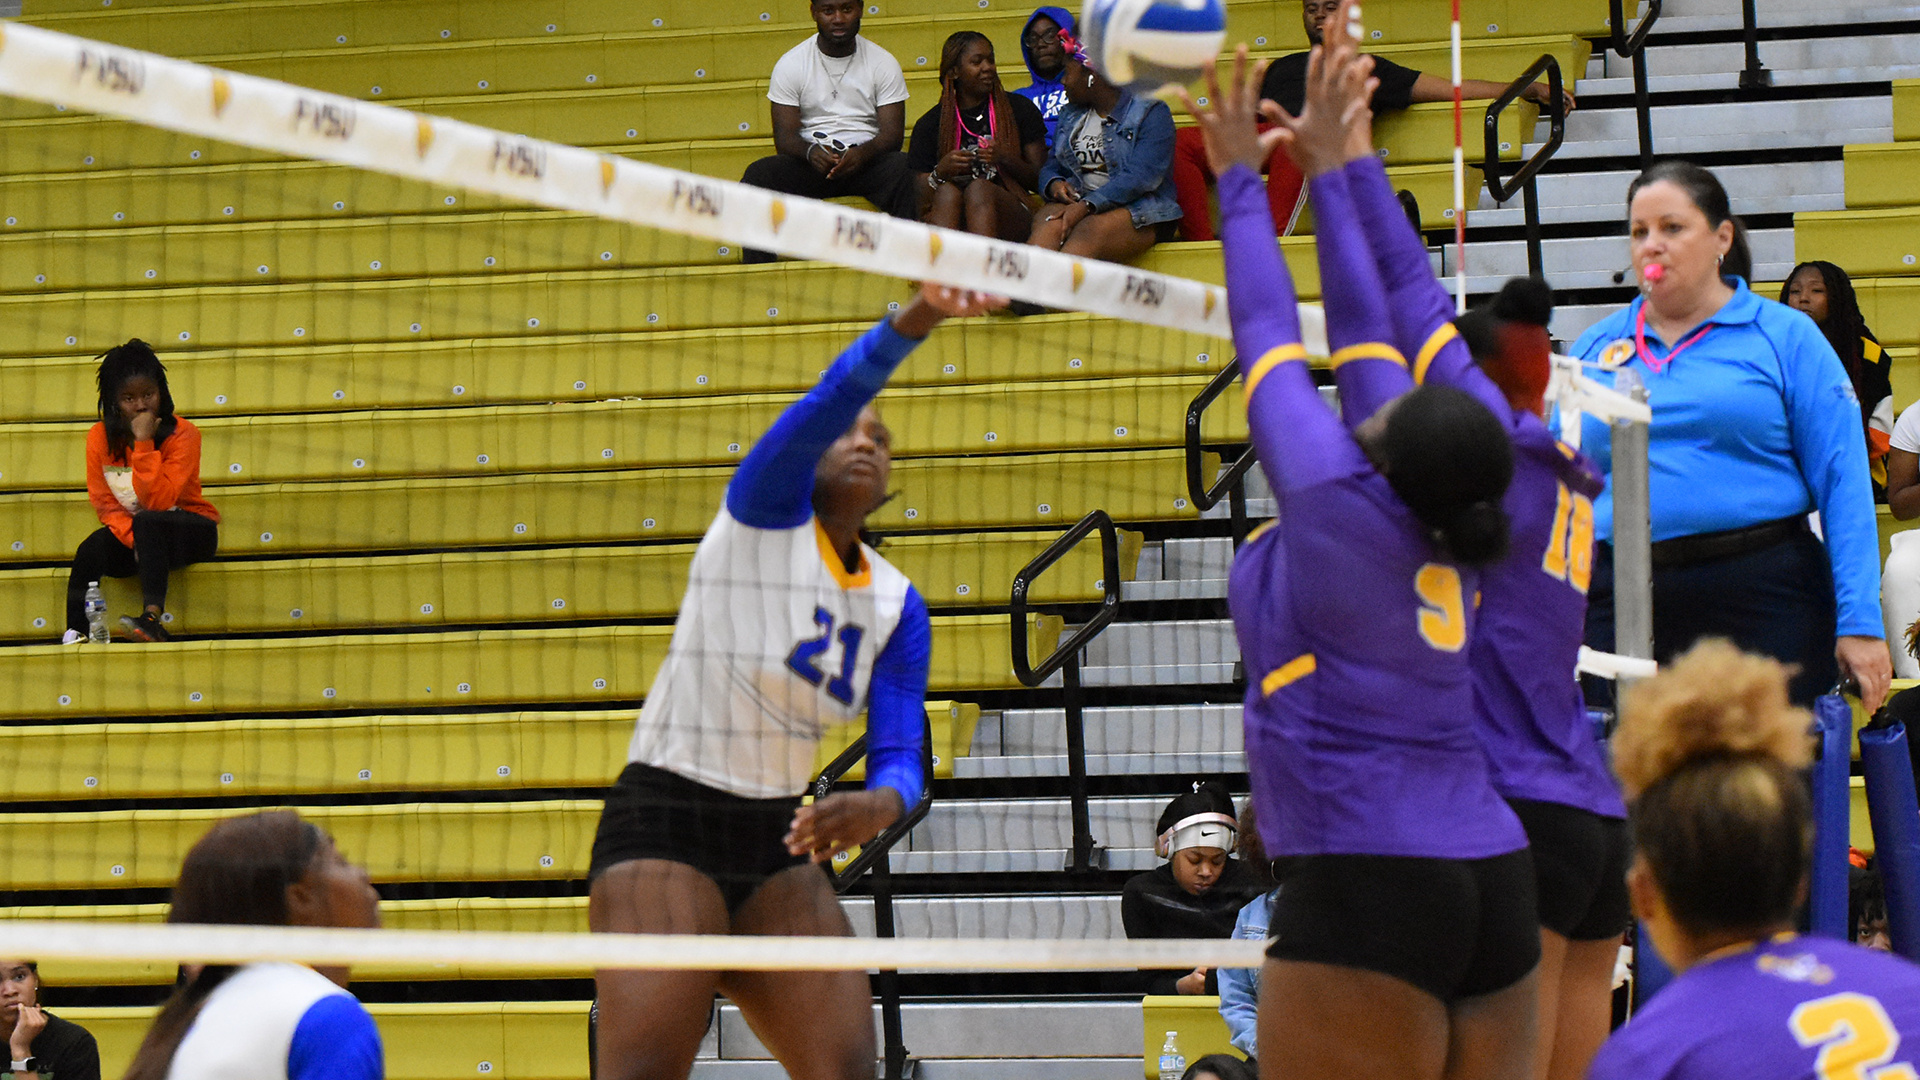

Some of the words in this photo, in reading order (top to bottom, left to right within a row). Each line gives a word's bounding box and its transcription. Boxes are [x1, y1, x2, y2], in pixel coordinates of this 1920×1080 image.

[1414, 562, 1467, 653] 9
[784, 604, 866, 707] 21
[1787, 991, 1920, 1080] 2
